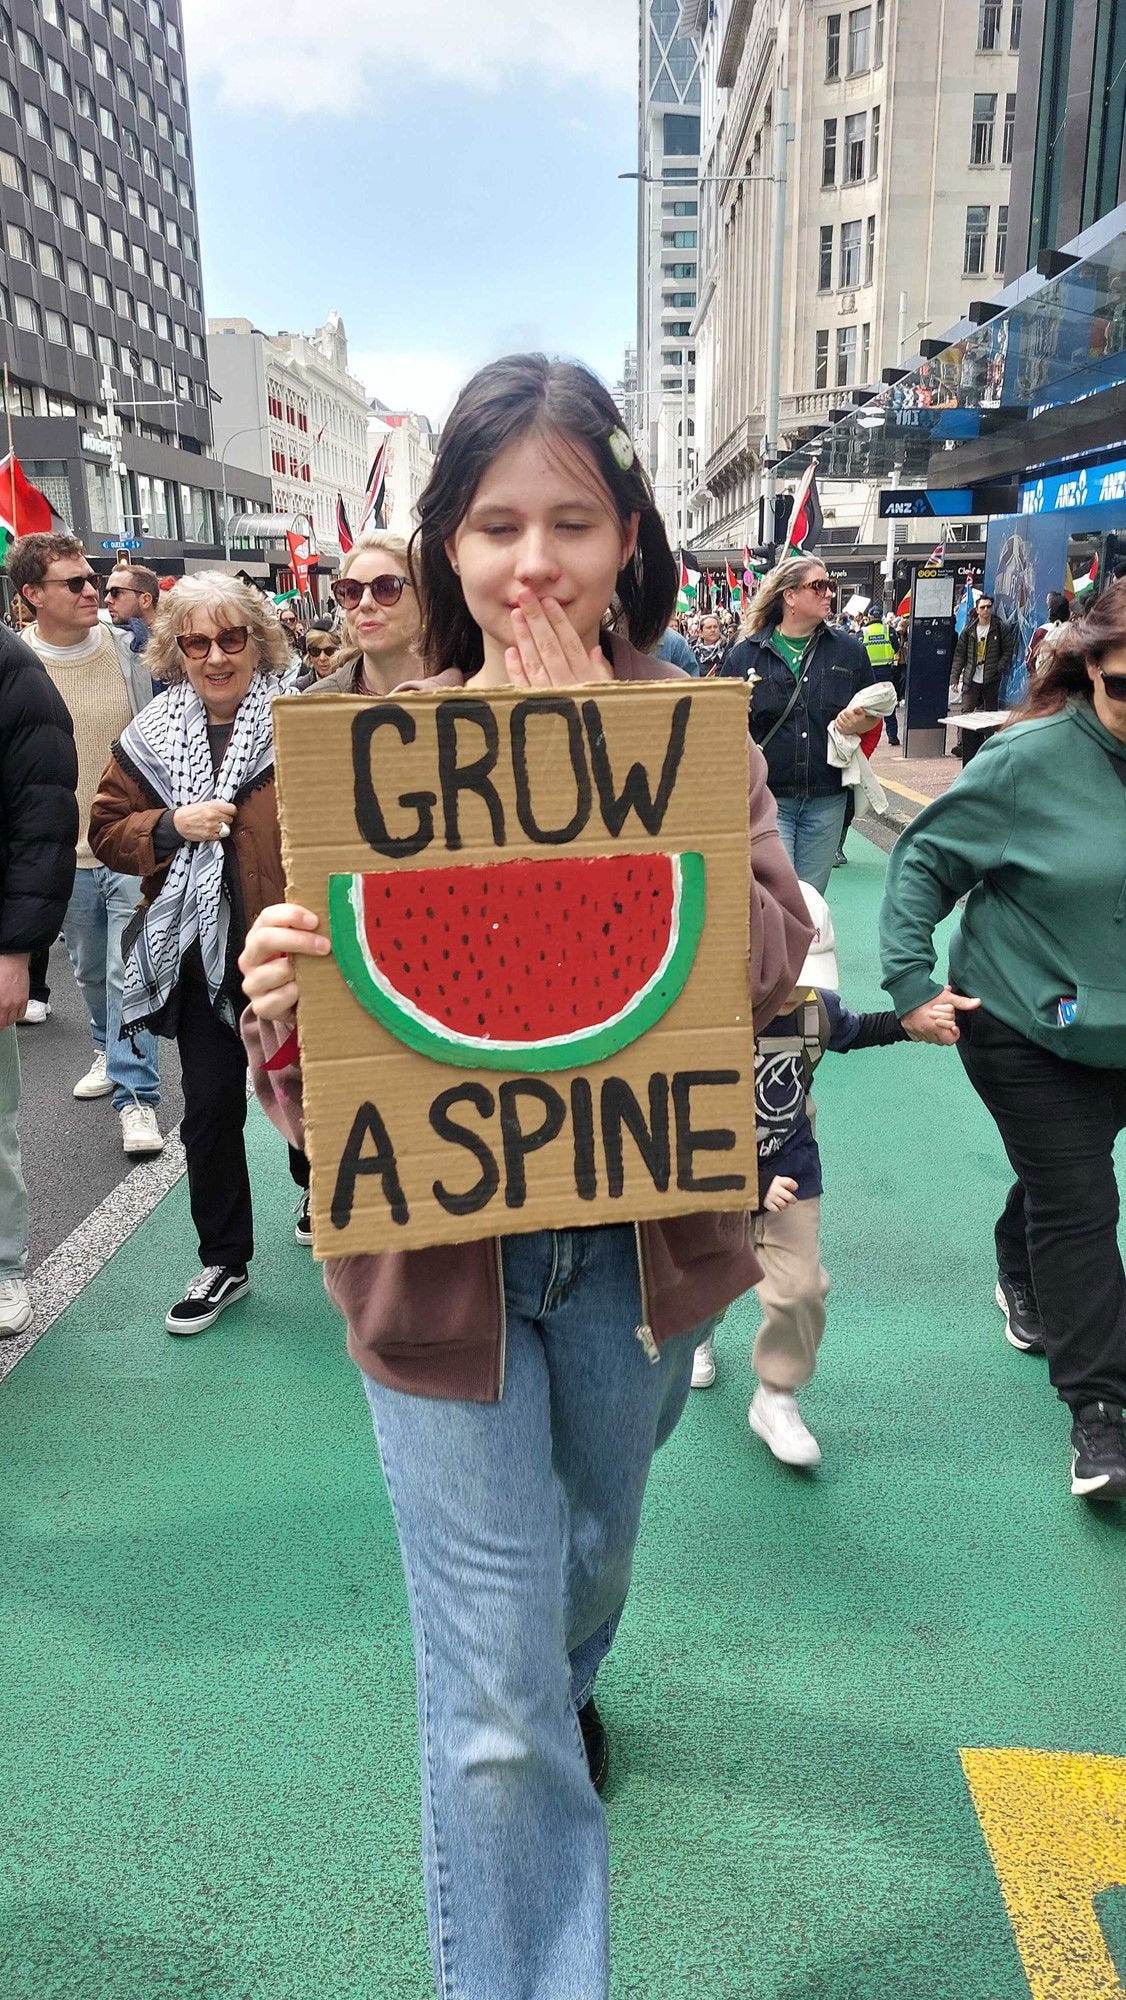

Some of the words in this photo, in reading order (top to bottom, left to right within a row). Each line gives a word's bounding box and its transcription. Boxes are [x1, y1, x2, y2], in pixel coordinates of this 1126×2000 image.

[1055, 481, 1077, 509] ANZ
[1099, 470, 1126, 502] ANZ
[885, 502, 912, 514] ANZ
[1022, 490, 1035, 514] NZ
[830, 570, 848, 578] Arpels
[352, 695, 692, 858] GROW
[331, 1101, 410, 1230] A
[428, 1070, 746, 1215] SPINE
